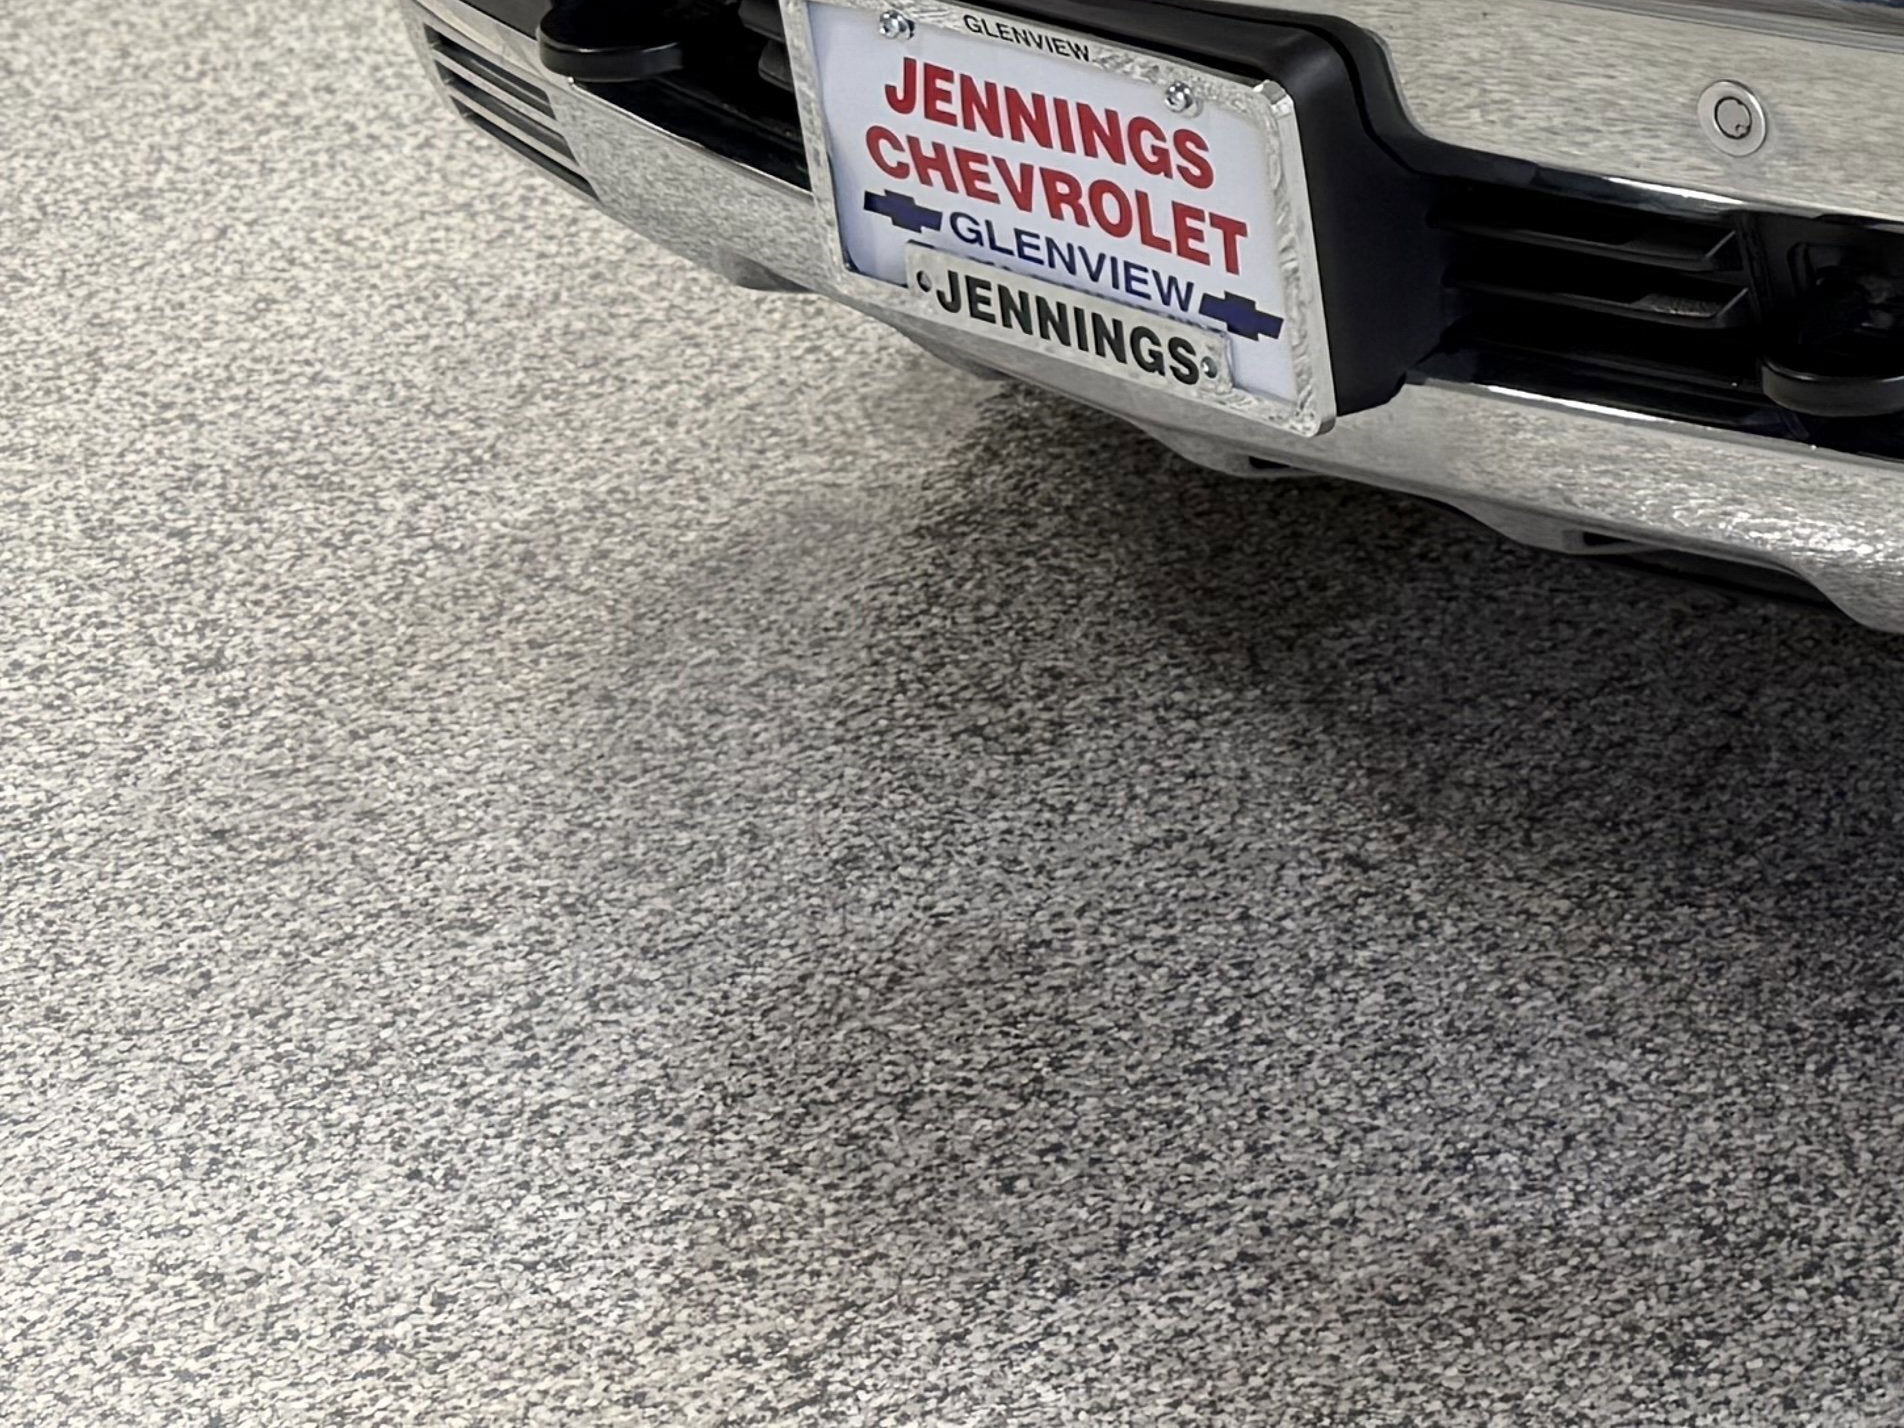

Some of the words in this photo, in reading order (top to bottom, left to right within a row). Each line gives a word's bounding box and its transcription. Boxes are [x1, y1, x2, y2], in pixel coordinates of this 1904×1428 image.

[962, 13, 1092, 63] GLENVIEW
[885, 57, 1214, 190] JENNINGS
[865, 125, 1248, 275] CHEVROLET
[948, 212, 1195, 313] GLENVIEW
[935, 269, 1200, 386] JENNINGS
